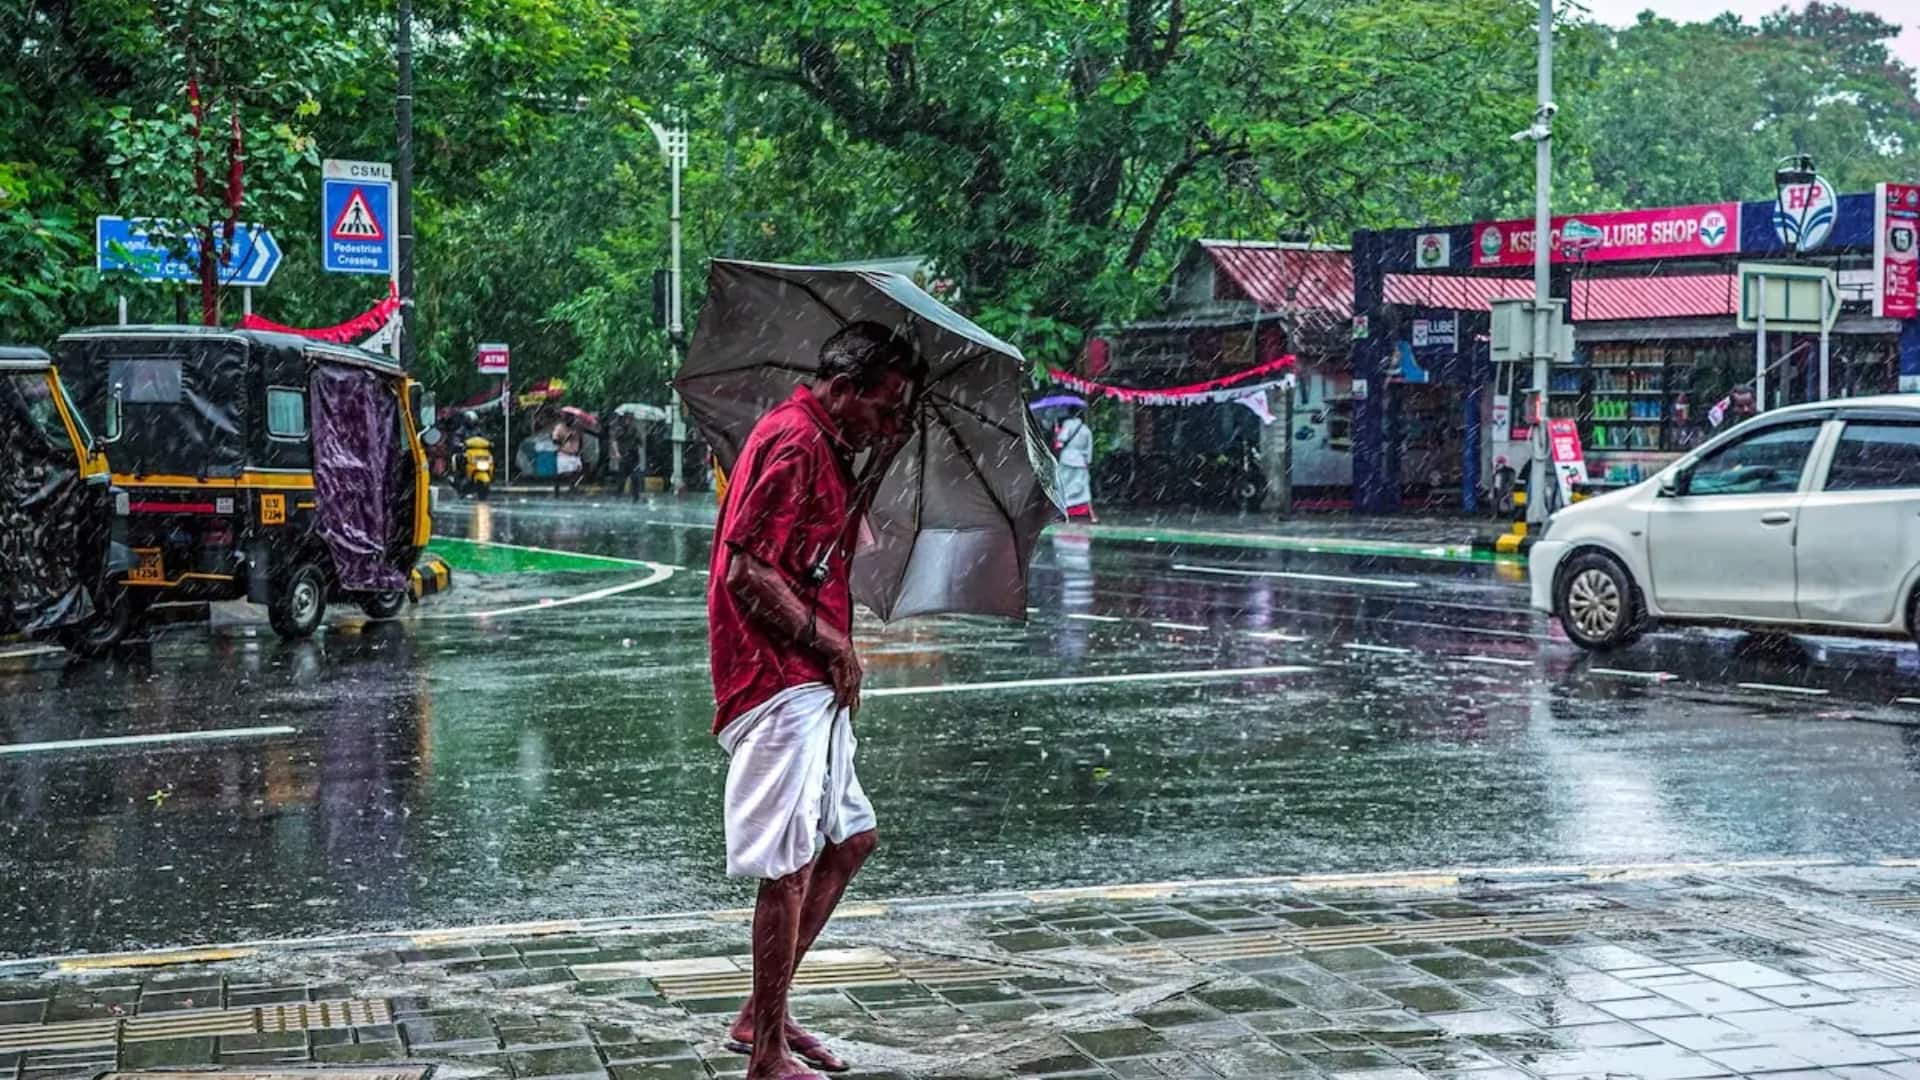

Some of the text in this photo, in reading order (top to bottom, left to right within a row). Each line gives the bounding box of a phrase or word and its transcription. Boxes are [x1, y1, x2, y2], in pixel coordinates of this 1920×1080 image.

[351, 164, 390, 178] CSML
[1788, 185, 1822, 209] HP
[1509, 218, 1698, 253] KSC LUBE SHOP
[333, 242, 383, 254] Pedestrian
[338, 255, 379, 268] Crossing
[1428, 320, 1454, 333] LUBE
[484, 354, 505, 364] ATM
